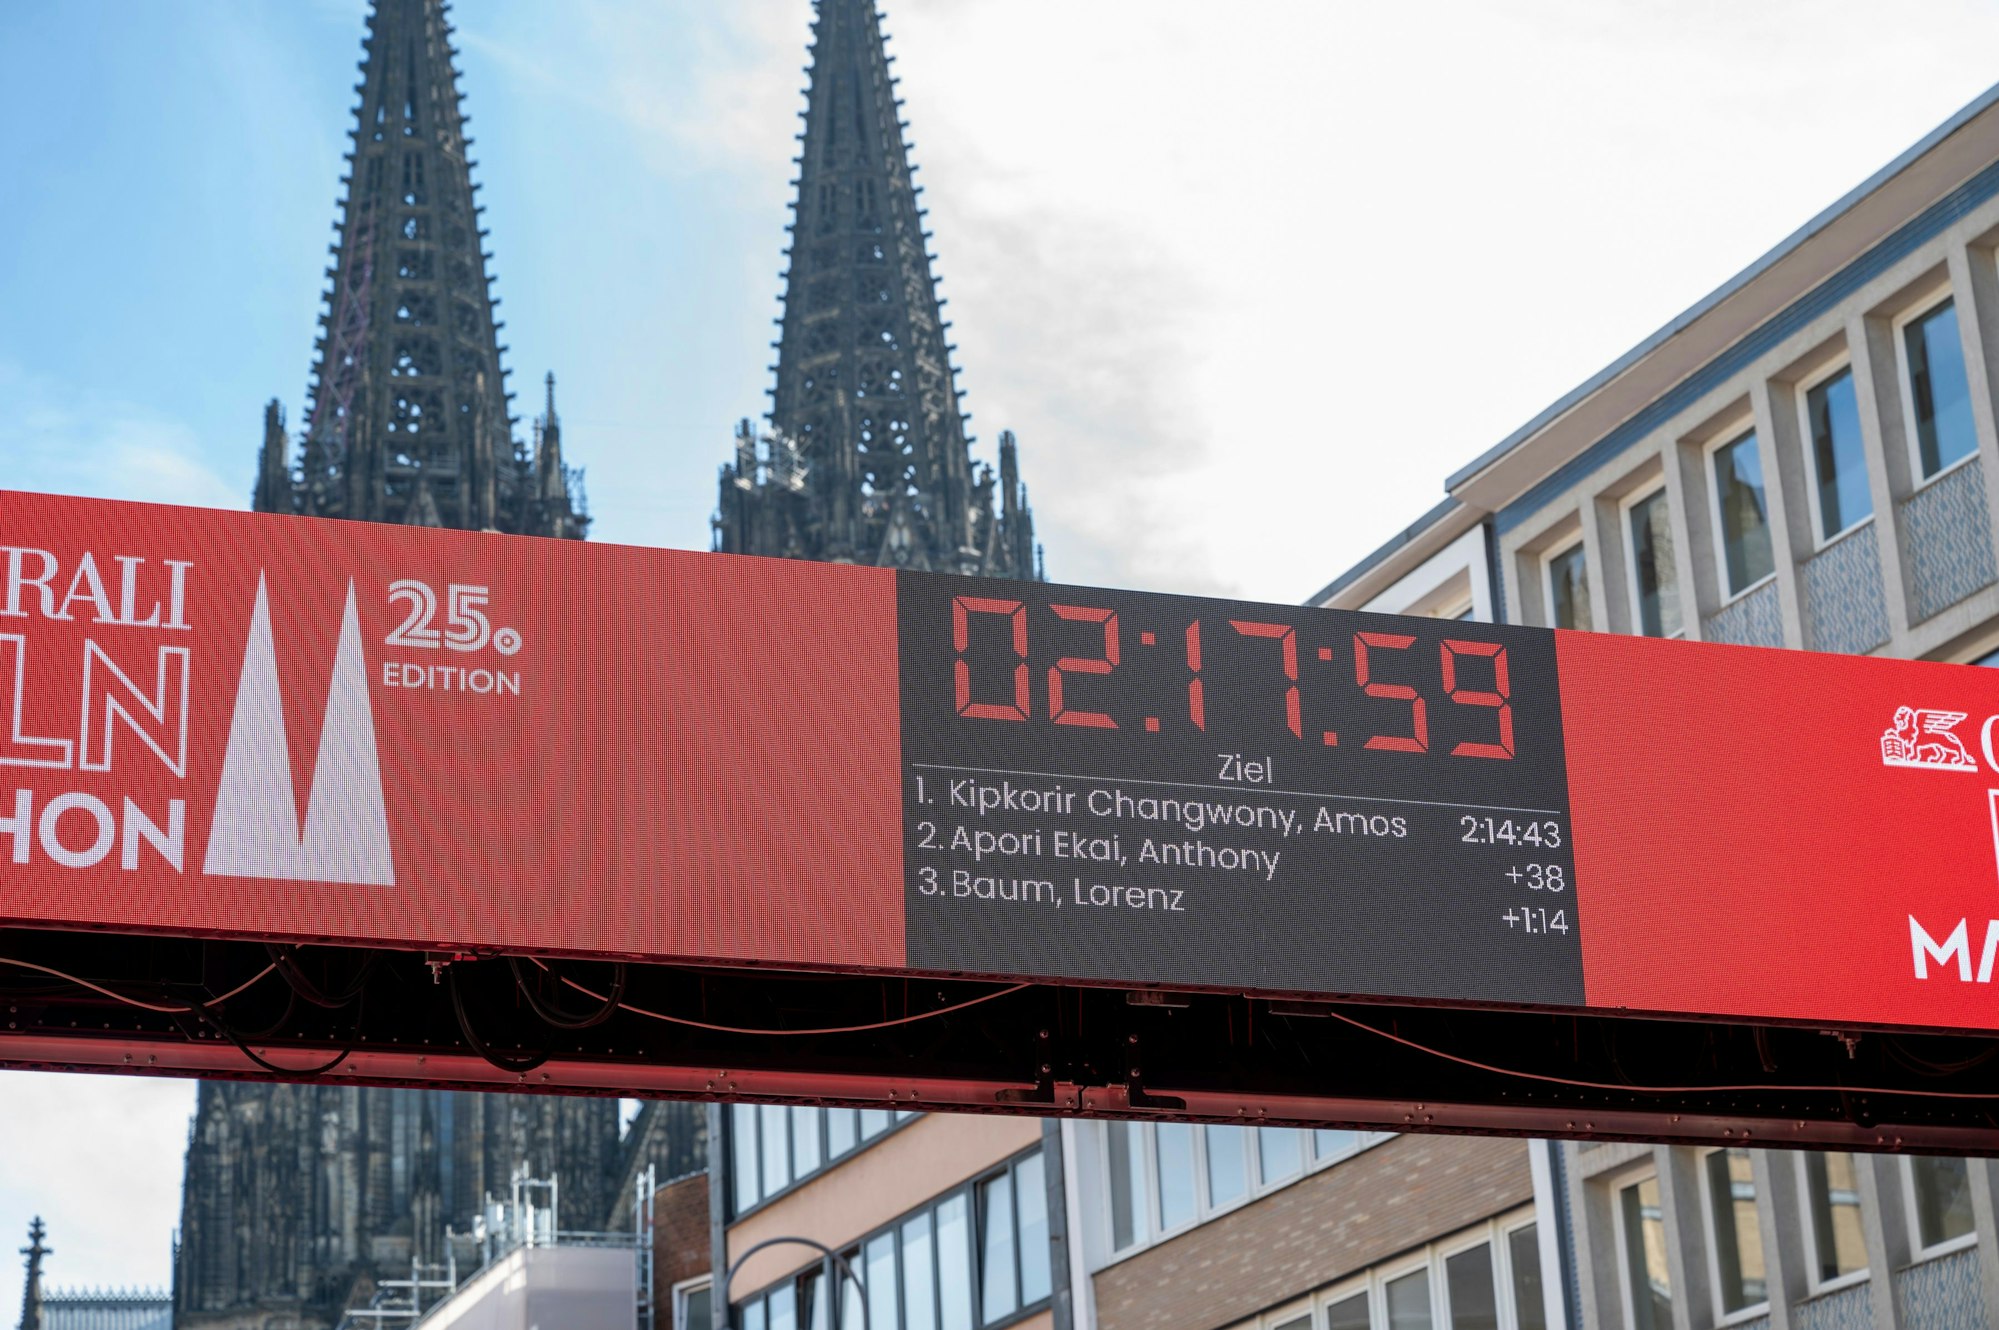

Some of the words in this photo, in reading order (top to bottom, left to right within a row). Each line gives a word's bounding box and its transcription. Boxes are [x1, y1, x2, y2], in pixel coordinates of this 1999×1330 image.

[383, 661, 520, 696] EDITION
[952, 596, 1515, 760] 02:17:59
[1218, 754, 1273, 783] Ziel
[916, 775, 933, 804] 1.
[950, 778, 1076, 815] Kipkorir
[1088, 789, 1303, 837] Changwony,
[1313, 806, 1408, 838] Amos
[1460, 815, 1562, 848] 2:14:43
[917, 821, 945, 851] 2.
[950, 826, 1041, 861] Apori
[1054, 830, 1128, 867] Ekai,
[1138, 838, 1281, 880] Anthony
[1504, 864, 1566, 892] +38
[918, 866, 946, 896] 3.
[953, 870, 1063, 909] Baum,
[1074, 878, 1186, 911] Lorenz
[1502, 907, 1569, 935] +1:14
